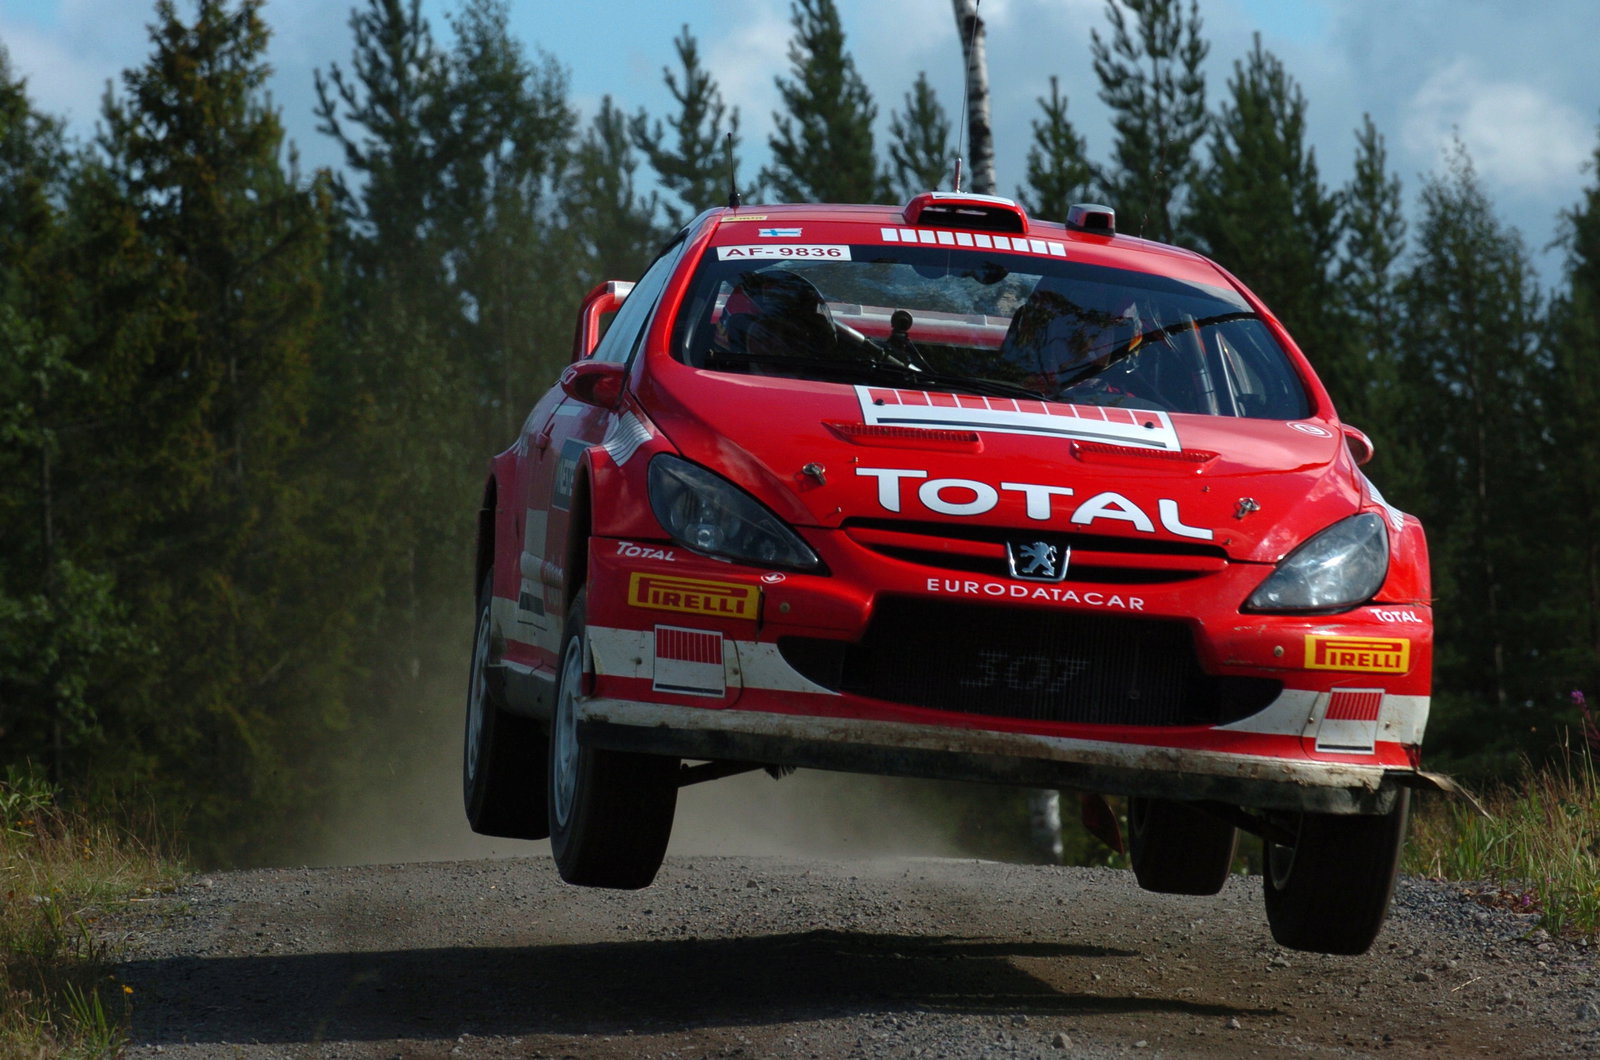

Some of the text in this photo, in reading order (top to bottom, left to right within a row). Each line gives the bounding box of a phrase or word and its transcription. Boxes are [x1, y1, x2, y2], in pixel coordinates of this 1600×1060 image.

[726, 247, 842, 257] AF-9836
[855, 467, 1214, 540] TOTAL
[616, 541, 676, 562] TOTAL
[637, 577, 749, 614] PIRELLI
[926, 577, 1145, 611] EURODATACAR
[1370, 608, 1424, 623] TOTAL
[1314, 638, 1403, 669] PIRELLI
[959, 650, 1090, 692] 307
